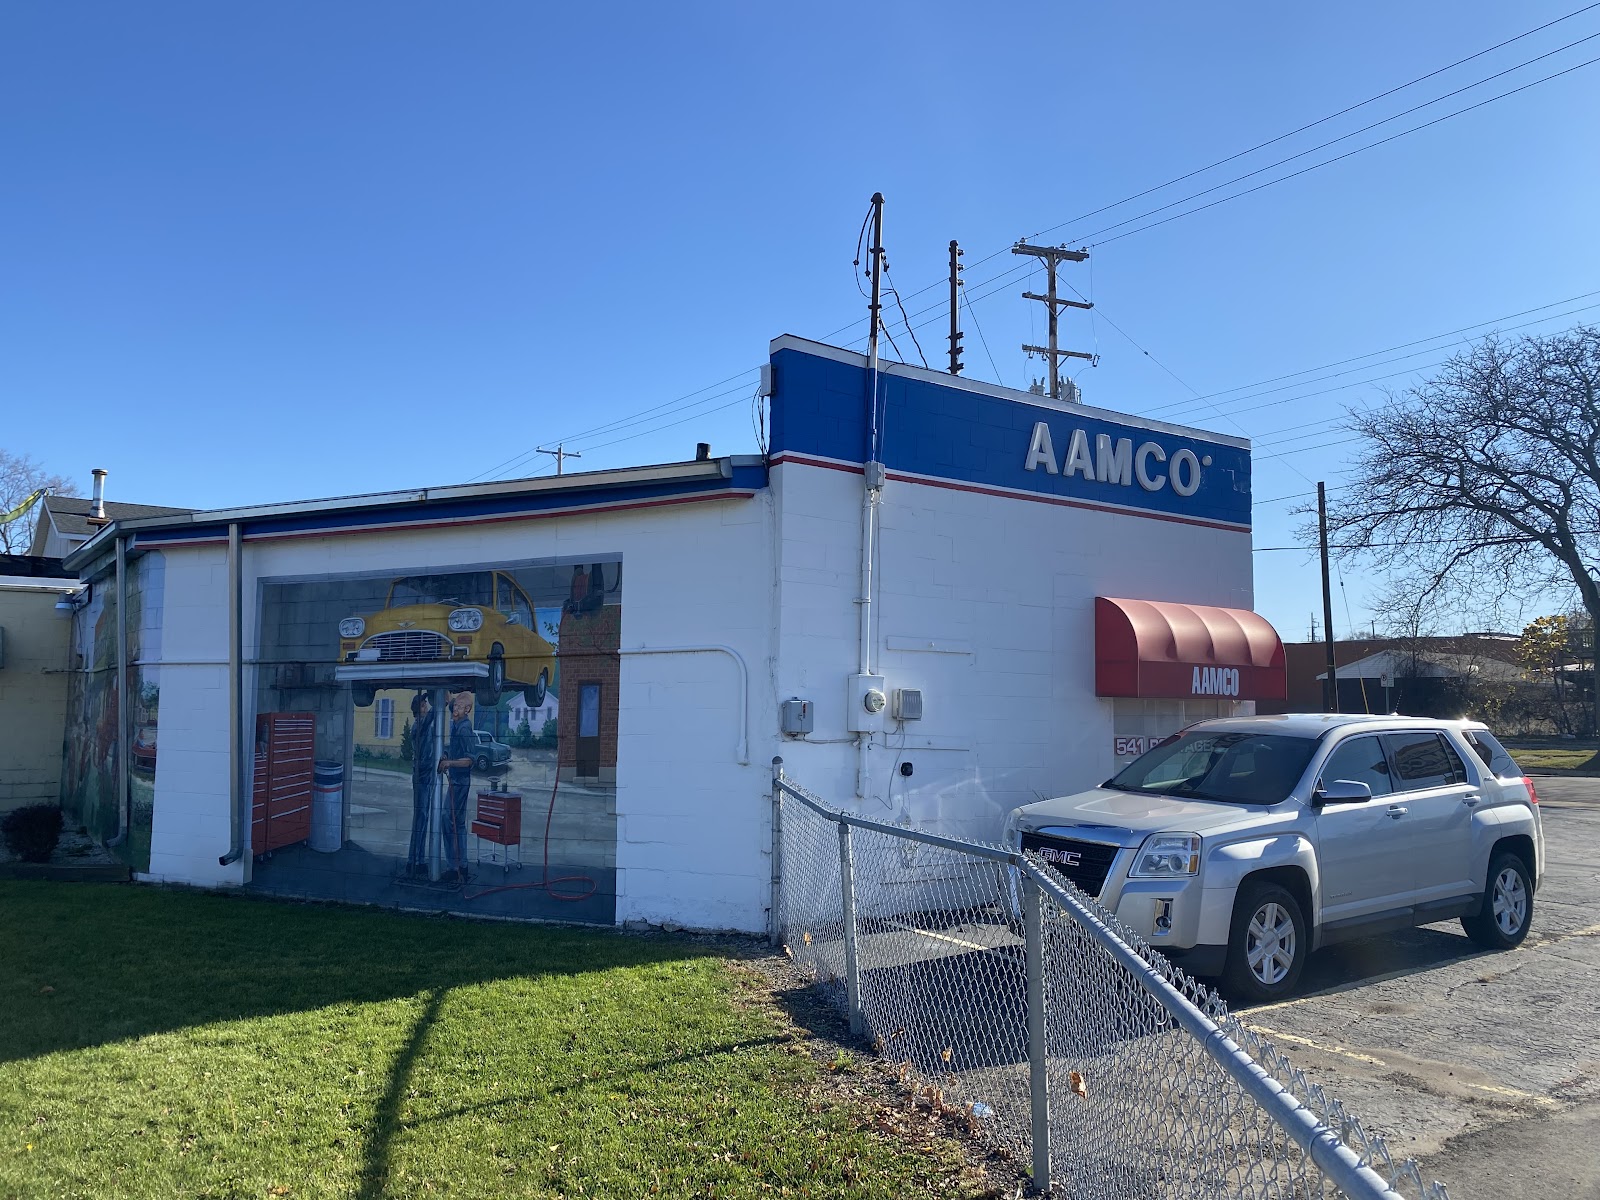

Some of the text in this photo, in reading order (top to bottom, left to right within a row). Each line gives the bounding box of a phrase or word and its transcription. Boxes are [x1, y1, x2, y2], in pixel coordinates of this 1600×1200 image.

[1024, 421, 1201, 497] AAMCO
[1191, 666, 1240, 697] AAMCO
[1116, 738, 1145, 756] 541
[1039, 847, 1082, 866] GMC
